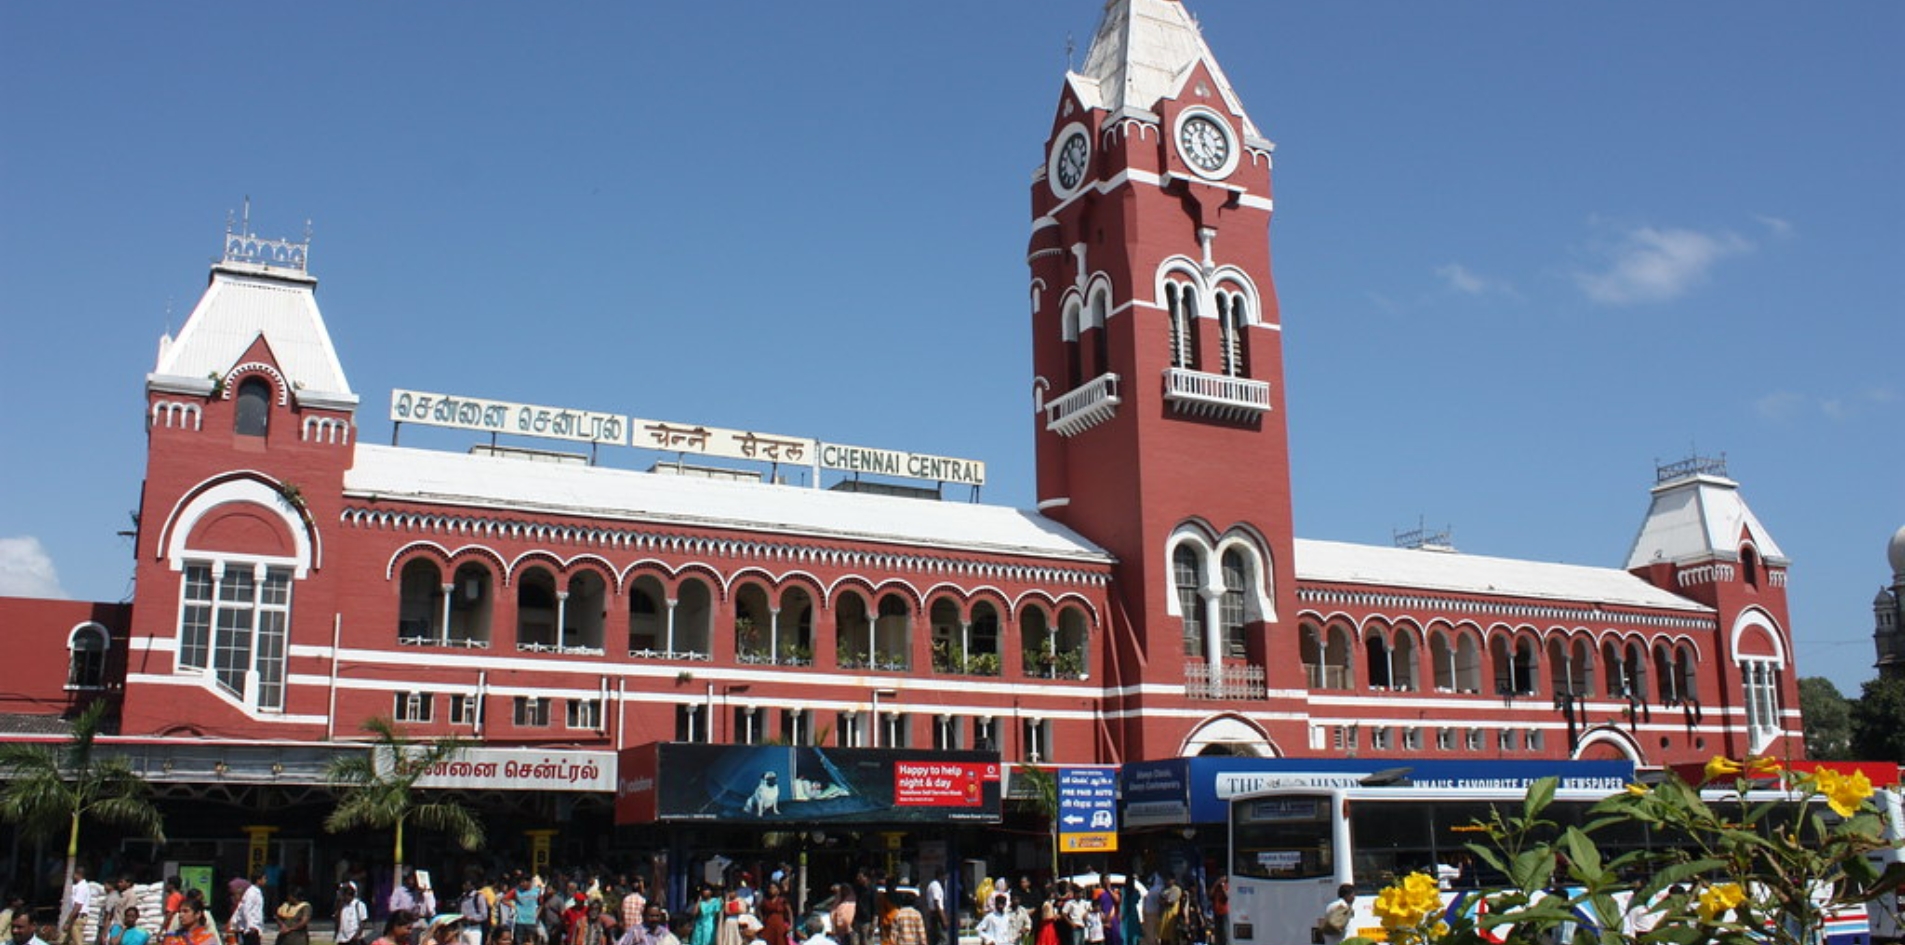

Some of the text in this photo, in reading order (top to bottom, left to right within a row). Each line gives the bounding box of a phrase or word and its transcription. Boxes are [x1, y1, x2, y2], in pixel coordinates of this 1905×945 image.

[823, 446, 982, 483] CHENNAI CENTRAL
[899, 765, 963, 777] Happy to help
[899, 778, 952, 789] night & day
[1227, 778, 1360, 793] THE HIND
[1458, 779, 1518, 788] FAVOURITE
[1563, 777, 1623, 789] NEWSPAPER
